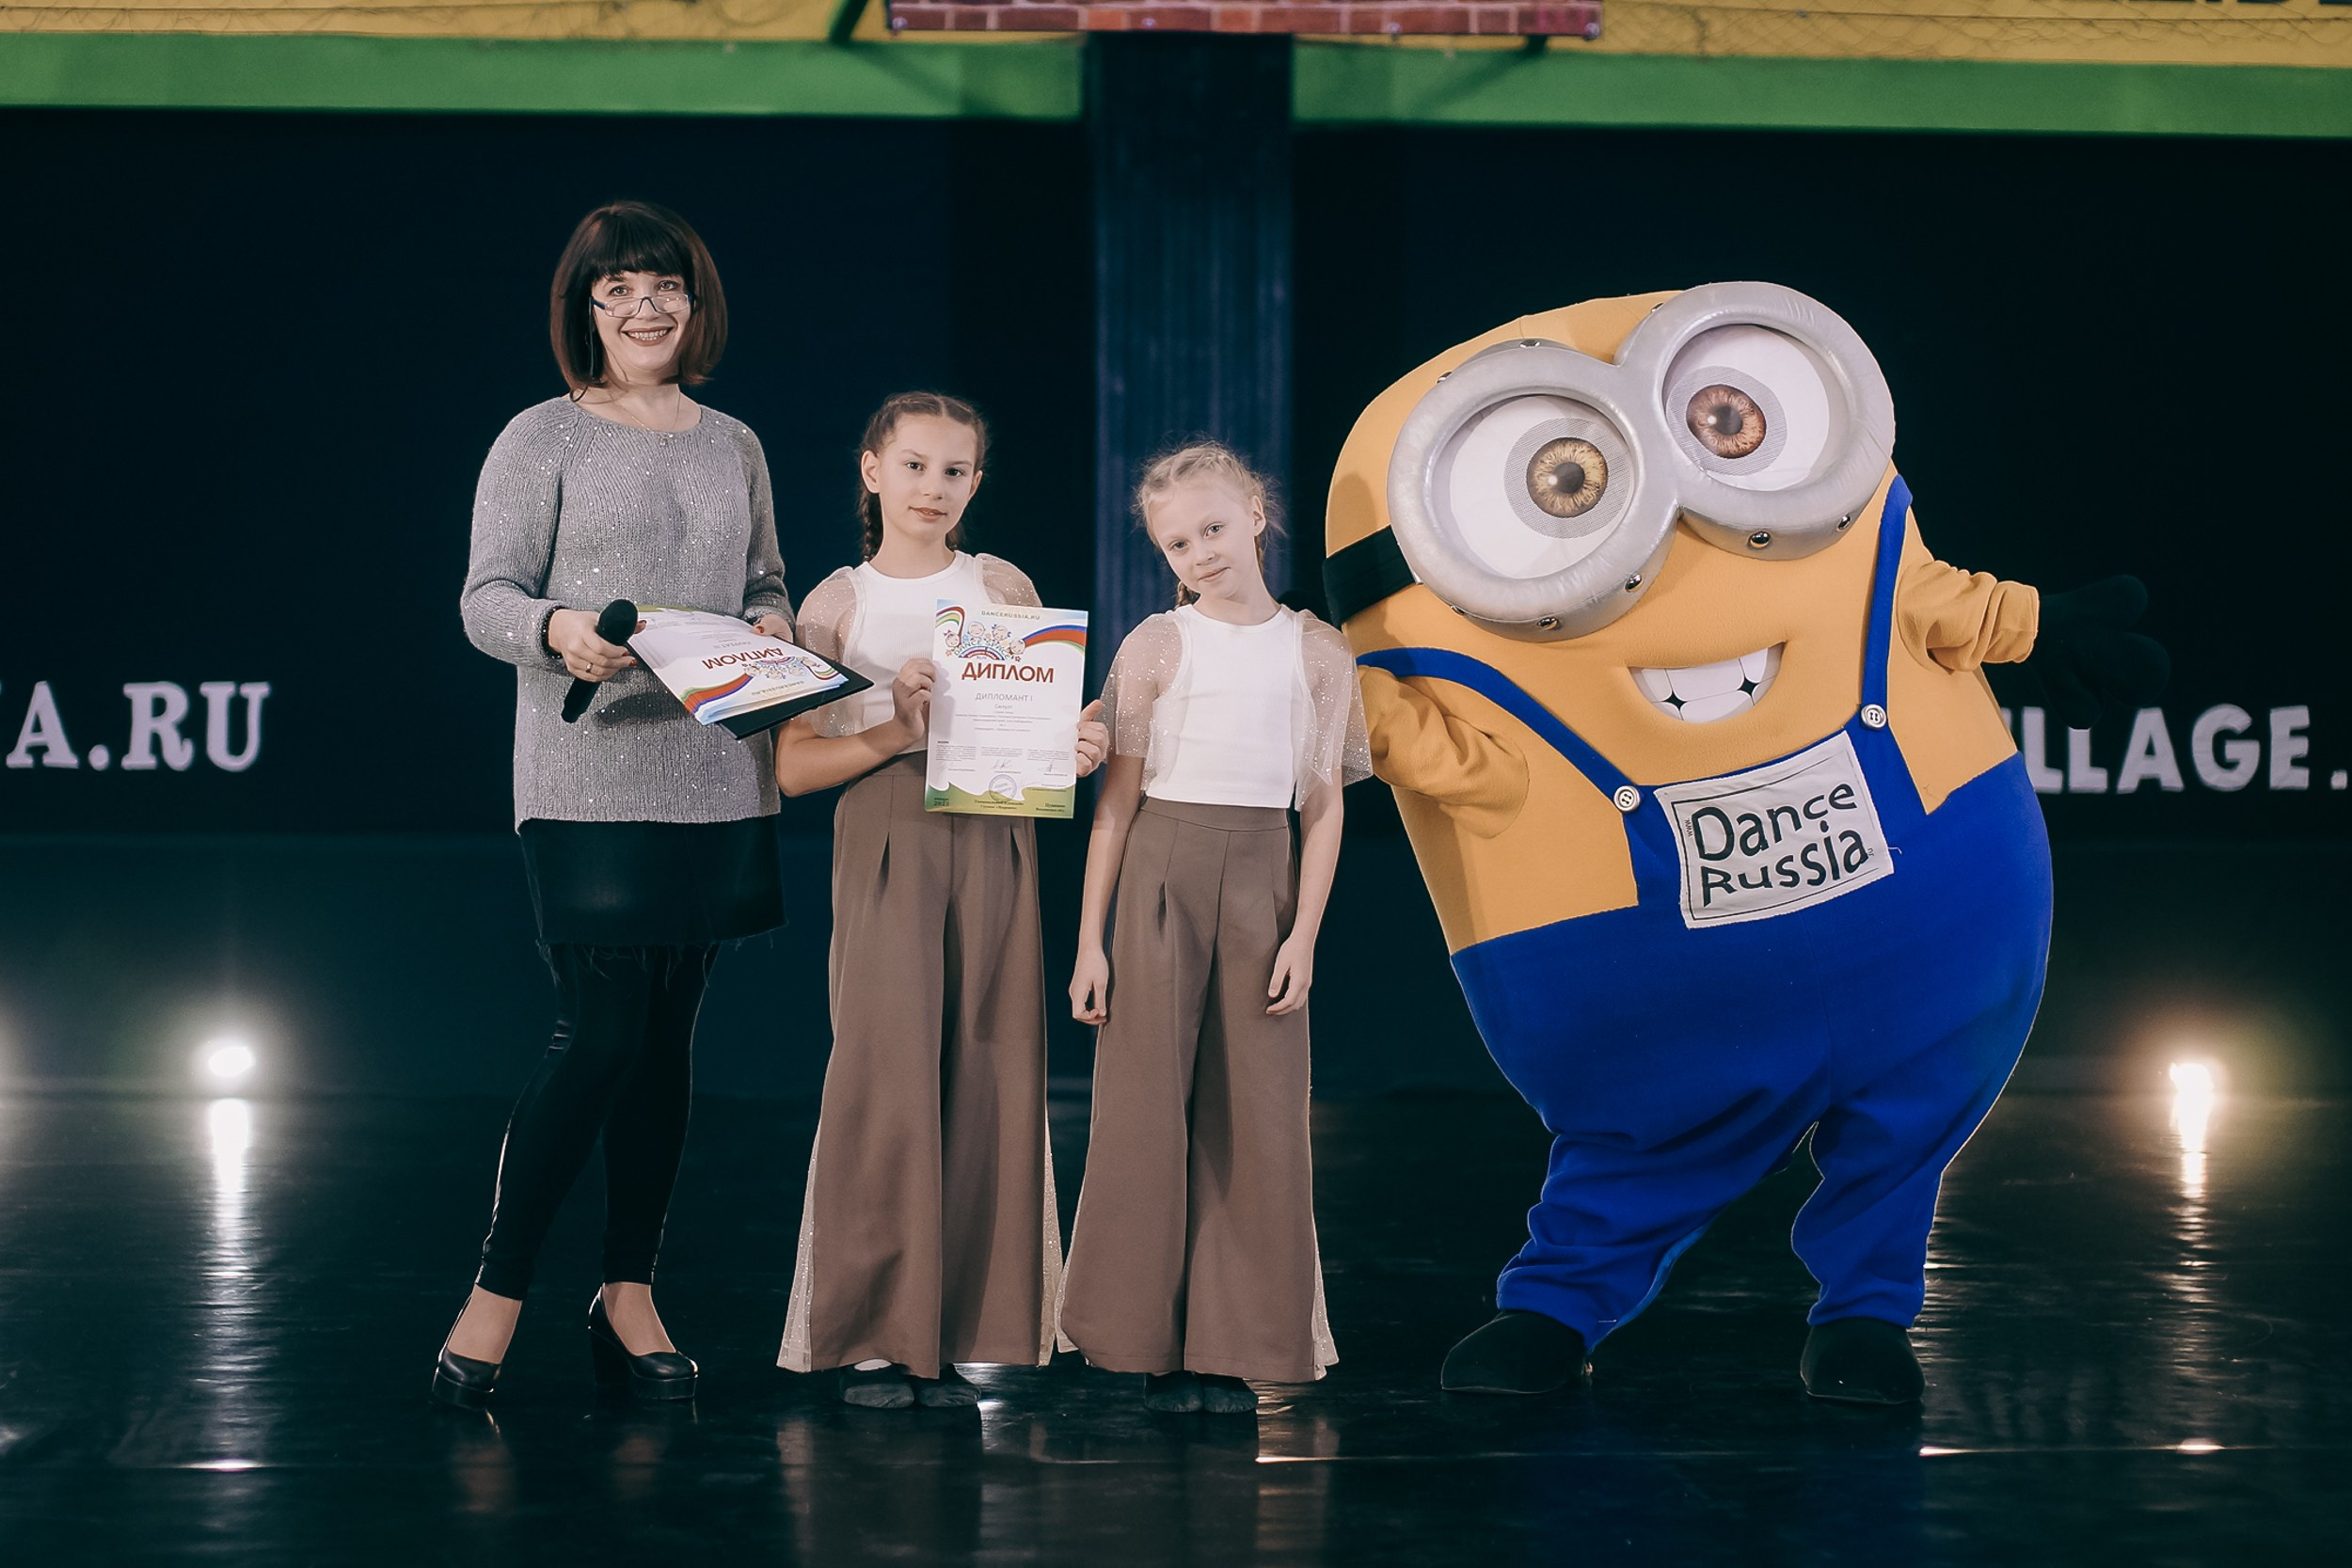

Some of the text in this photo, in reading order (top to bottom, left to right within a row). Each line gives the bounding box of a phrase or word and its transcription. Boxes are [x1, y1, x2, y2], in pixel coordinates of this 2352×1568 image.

[981, 610, 1041, 621] DANCERUSSIA.RU
[701, 646, 784, 670] ДИПЛОМ
[961, 661, 1054, 684] ДИПЛОМ
[975, 692, 1028, 702] ДИПЛОМАНТ
[0, 680, 271, 771] A.RU
[1691, 783, 1858, 862] Dance
[1700, 819, 1869, 908] Russia
